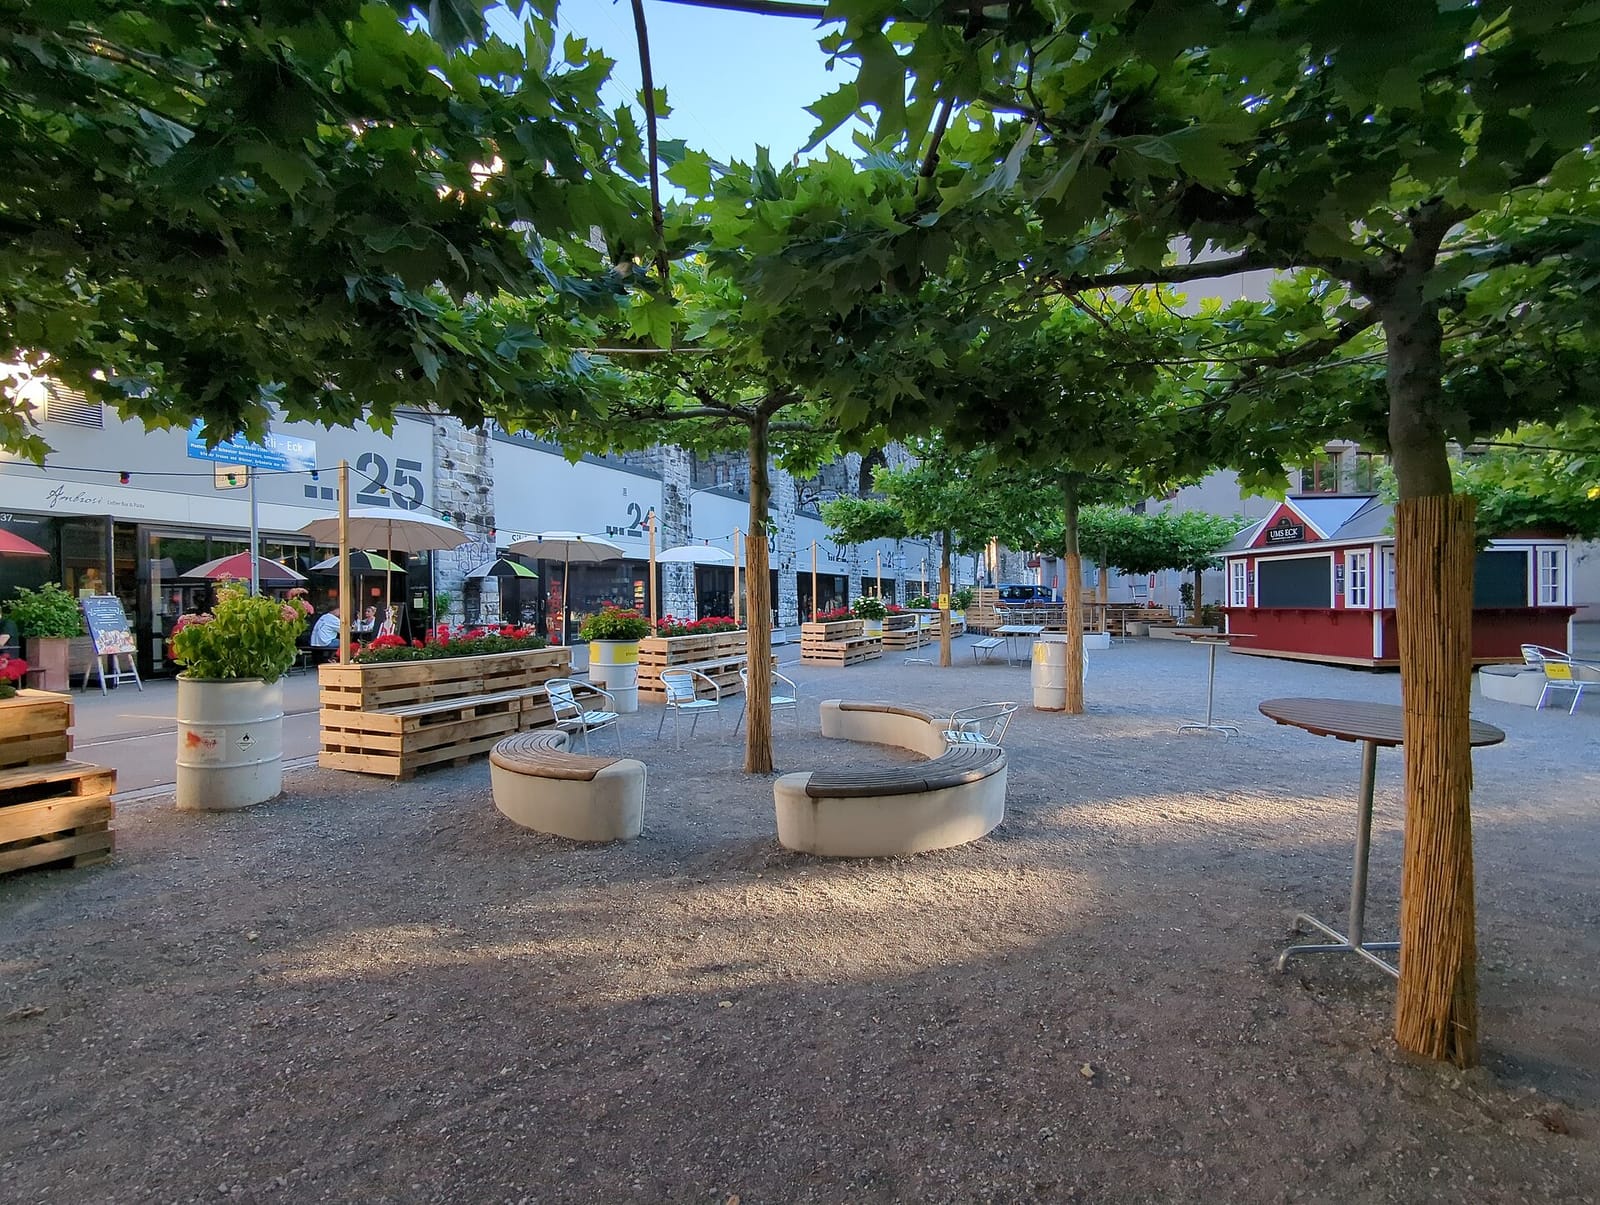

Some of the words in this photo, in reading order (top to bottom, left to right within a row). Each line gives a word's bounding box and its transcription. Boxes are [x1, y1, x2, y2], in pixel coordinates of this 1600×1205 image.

[287, 441, 303, 453] Eck
[46, 484, 103, 508] Ambrosi
[1270, 530, 1284, 538] UMS
[1285, 528, 1298, 536] ECK
